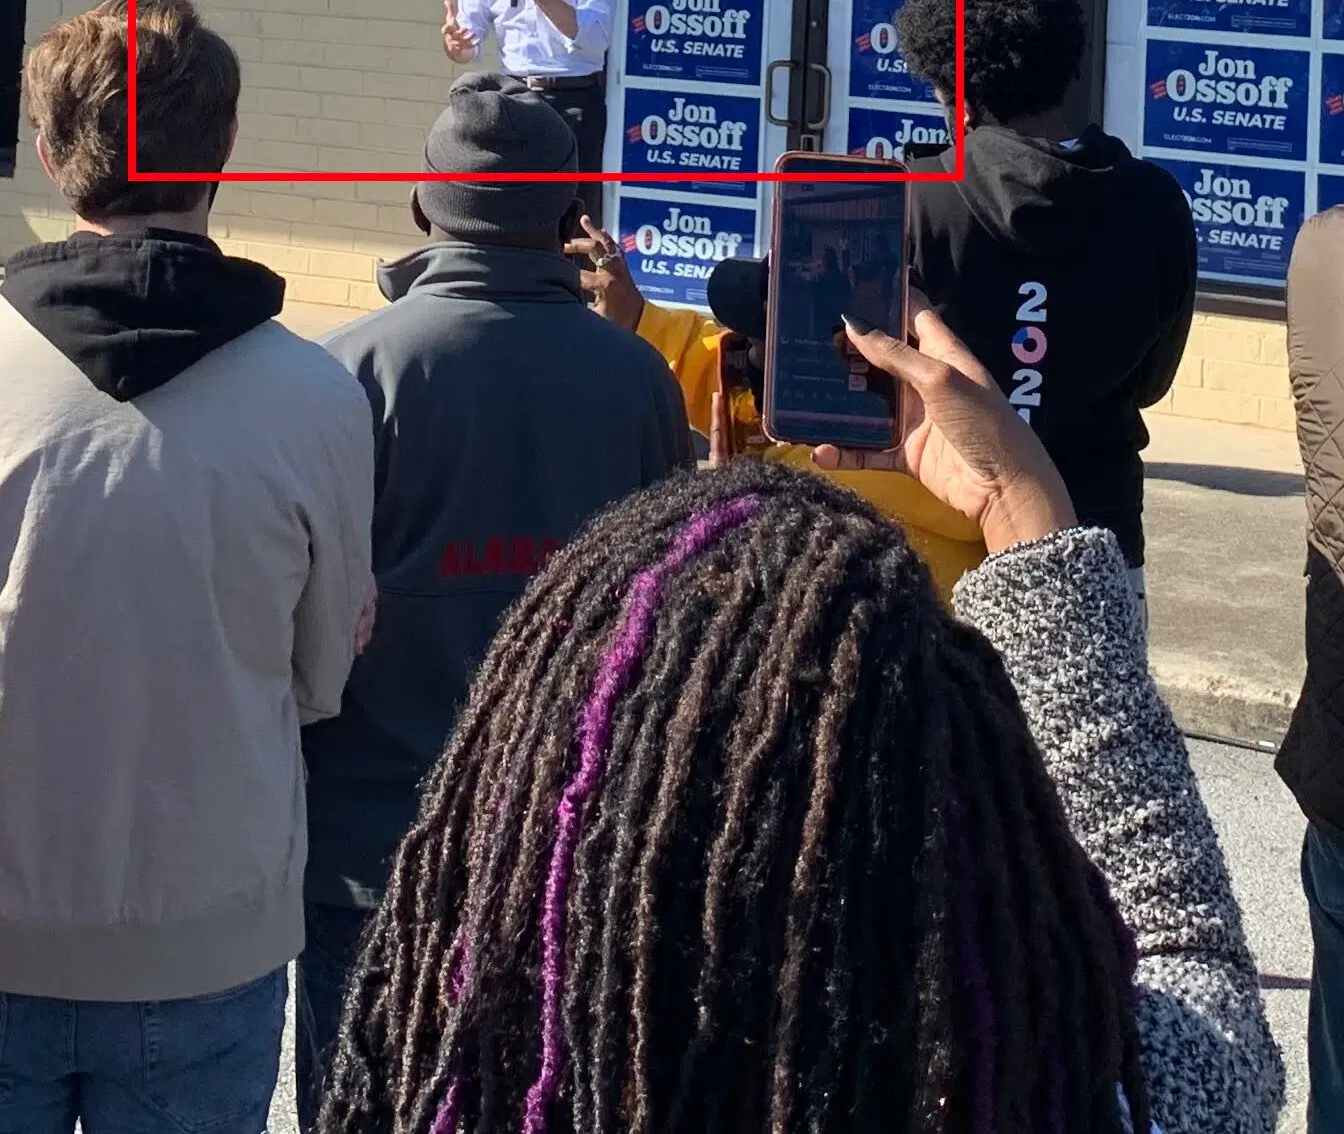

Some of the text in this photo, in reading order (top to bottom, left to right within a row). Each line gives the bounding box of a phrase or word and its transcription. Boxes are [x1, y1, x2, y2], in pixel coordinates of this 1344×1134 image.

[645, 5, 751, 39] Ossoff
[650, 38, 744, 58] U.S. SENATE
[1198, 50, 1256, 80] Jon
[1165, 68, 1293, 109] Ossoff
[668, 97, 717, 124] Jon
[1173, 106, 1287, 131] U.S. SENATE
[641, 115, 747, 151] Ossoff
[894, 119, 947, 144] Jon
[646, 149, 741, 170] U.S. SENATE
[1193, 168, 1252, 199] Jon
[663, 207, 712, 235] Jon
[1182, 189, 1289, 229] ssoff
[635, 224, 742, 262] Ossoff
[1207, 229, 1283, 251] SENATE
[641, 259, 670, 275] U.S.
